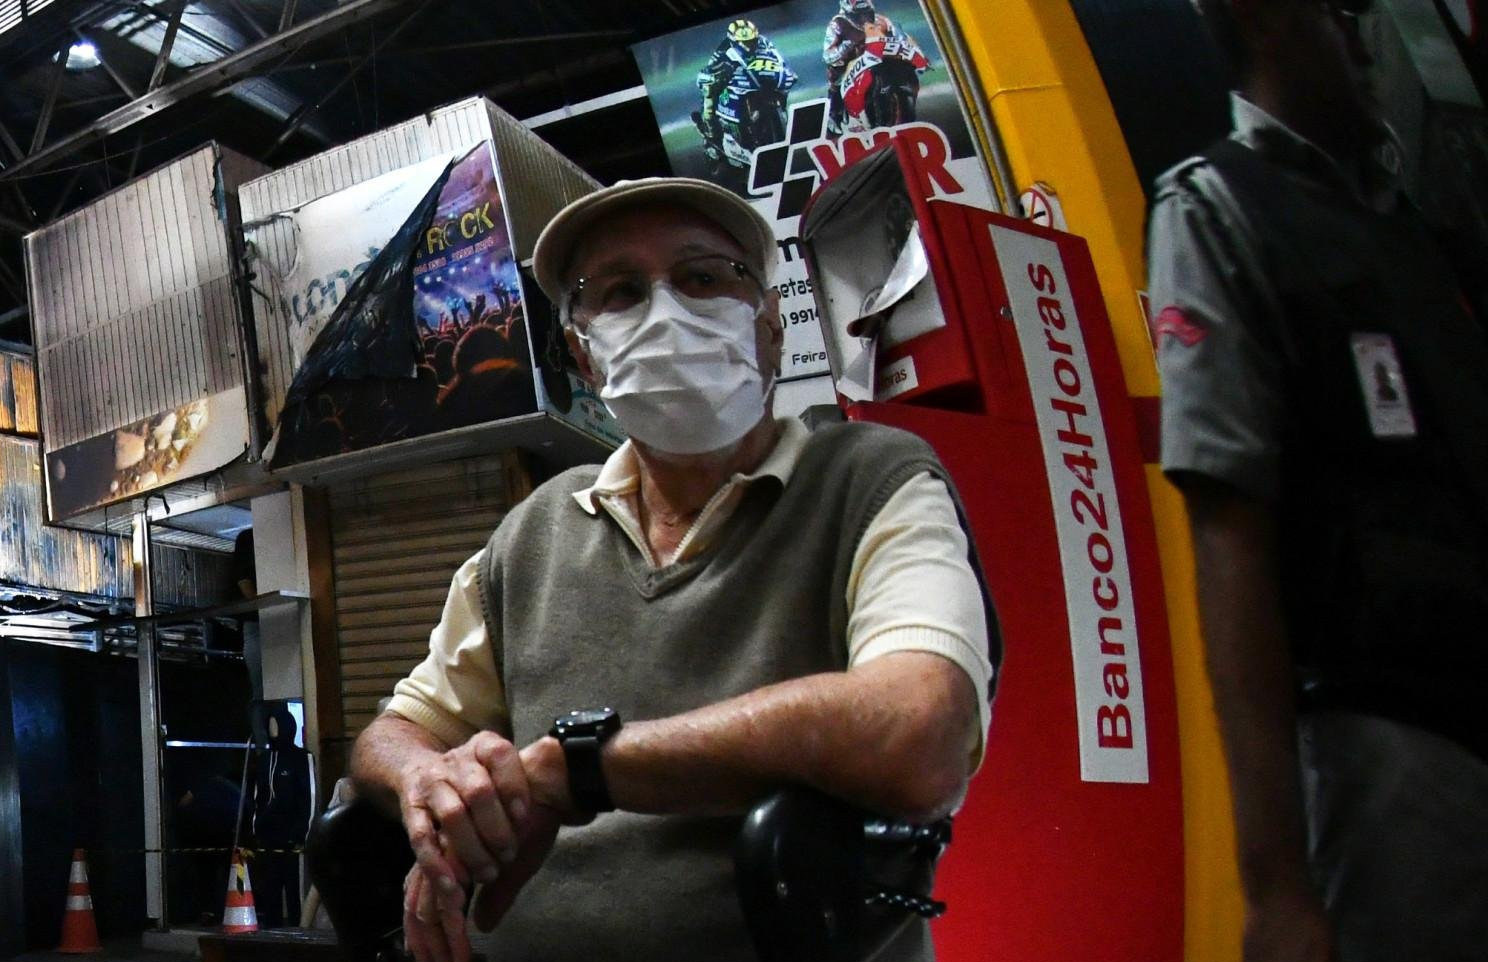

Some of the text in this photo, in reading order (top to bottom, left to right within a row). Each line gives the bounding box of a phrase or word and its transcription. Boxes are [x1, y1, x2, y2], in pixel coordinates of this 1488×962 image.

[883, 42, 914, 61] 93
[746, 59, 783, 73] 46
[792, 350, 827, 365] Feira
[1027, 262, 1134, 749] Banco24Horas
